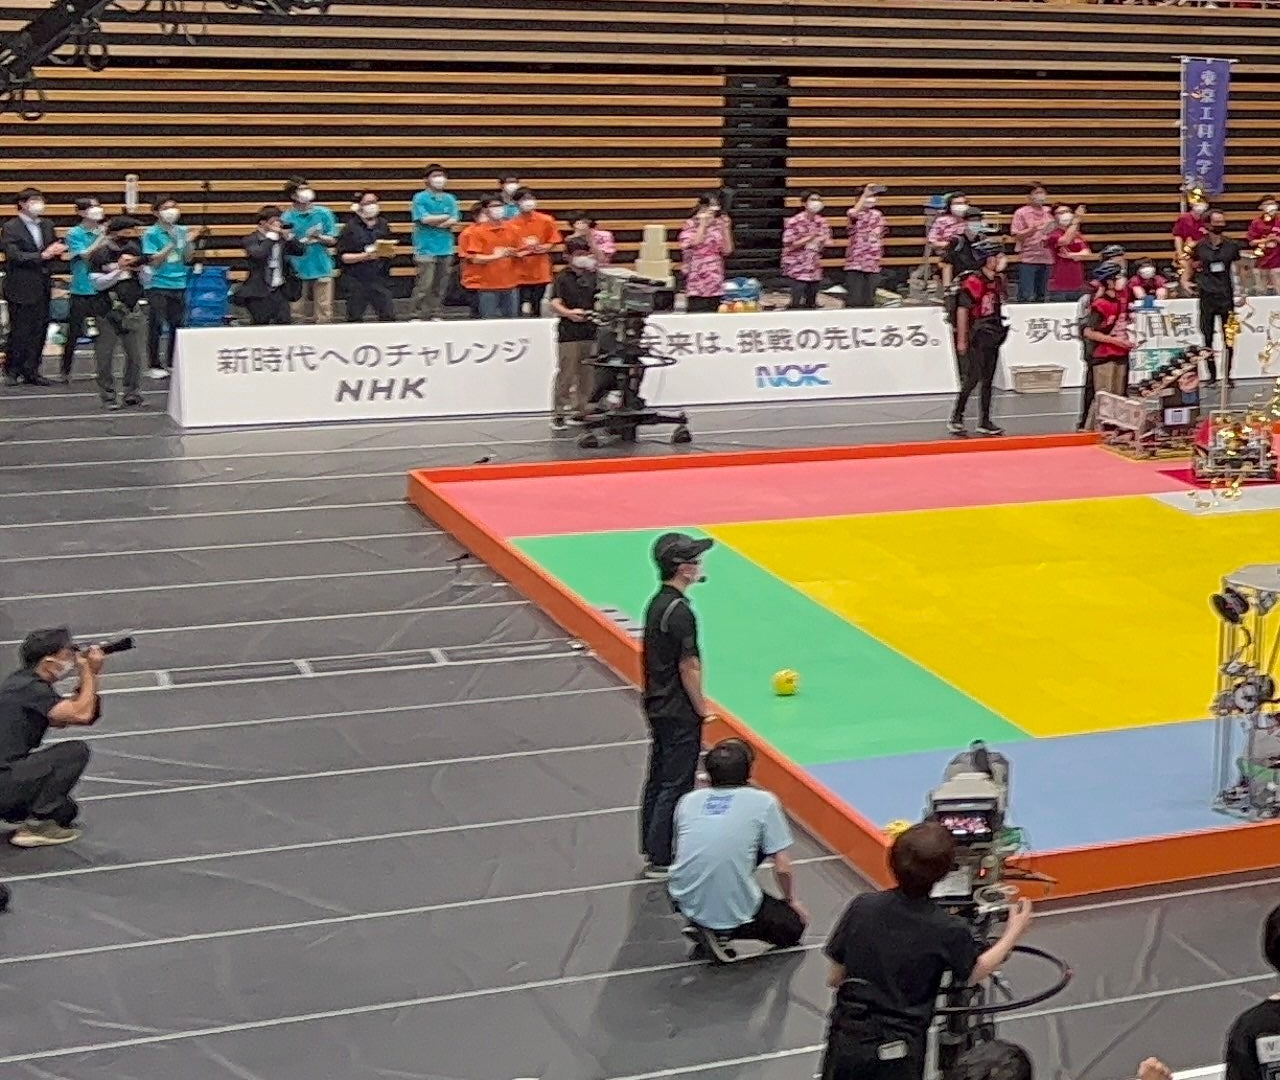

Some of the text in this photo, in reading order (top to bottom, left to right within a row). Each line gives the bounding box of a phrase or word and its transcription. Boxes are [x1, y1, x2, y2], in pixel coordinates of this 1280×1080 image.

[216, 338, 529, 375] 新時代へのチャレンジ
[755, 363, 832, 388] NOK
[334, 377, 428, 403] NHK
